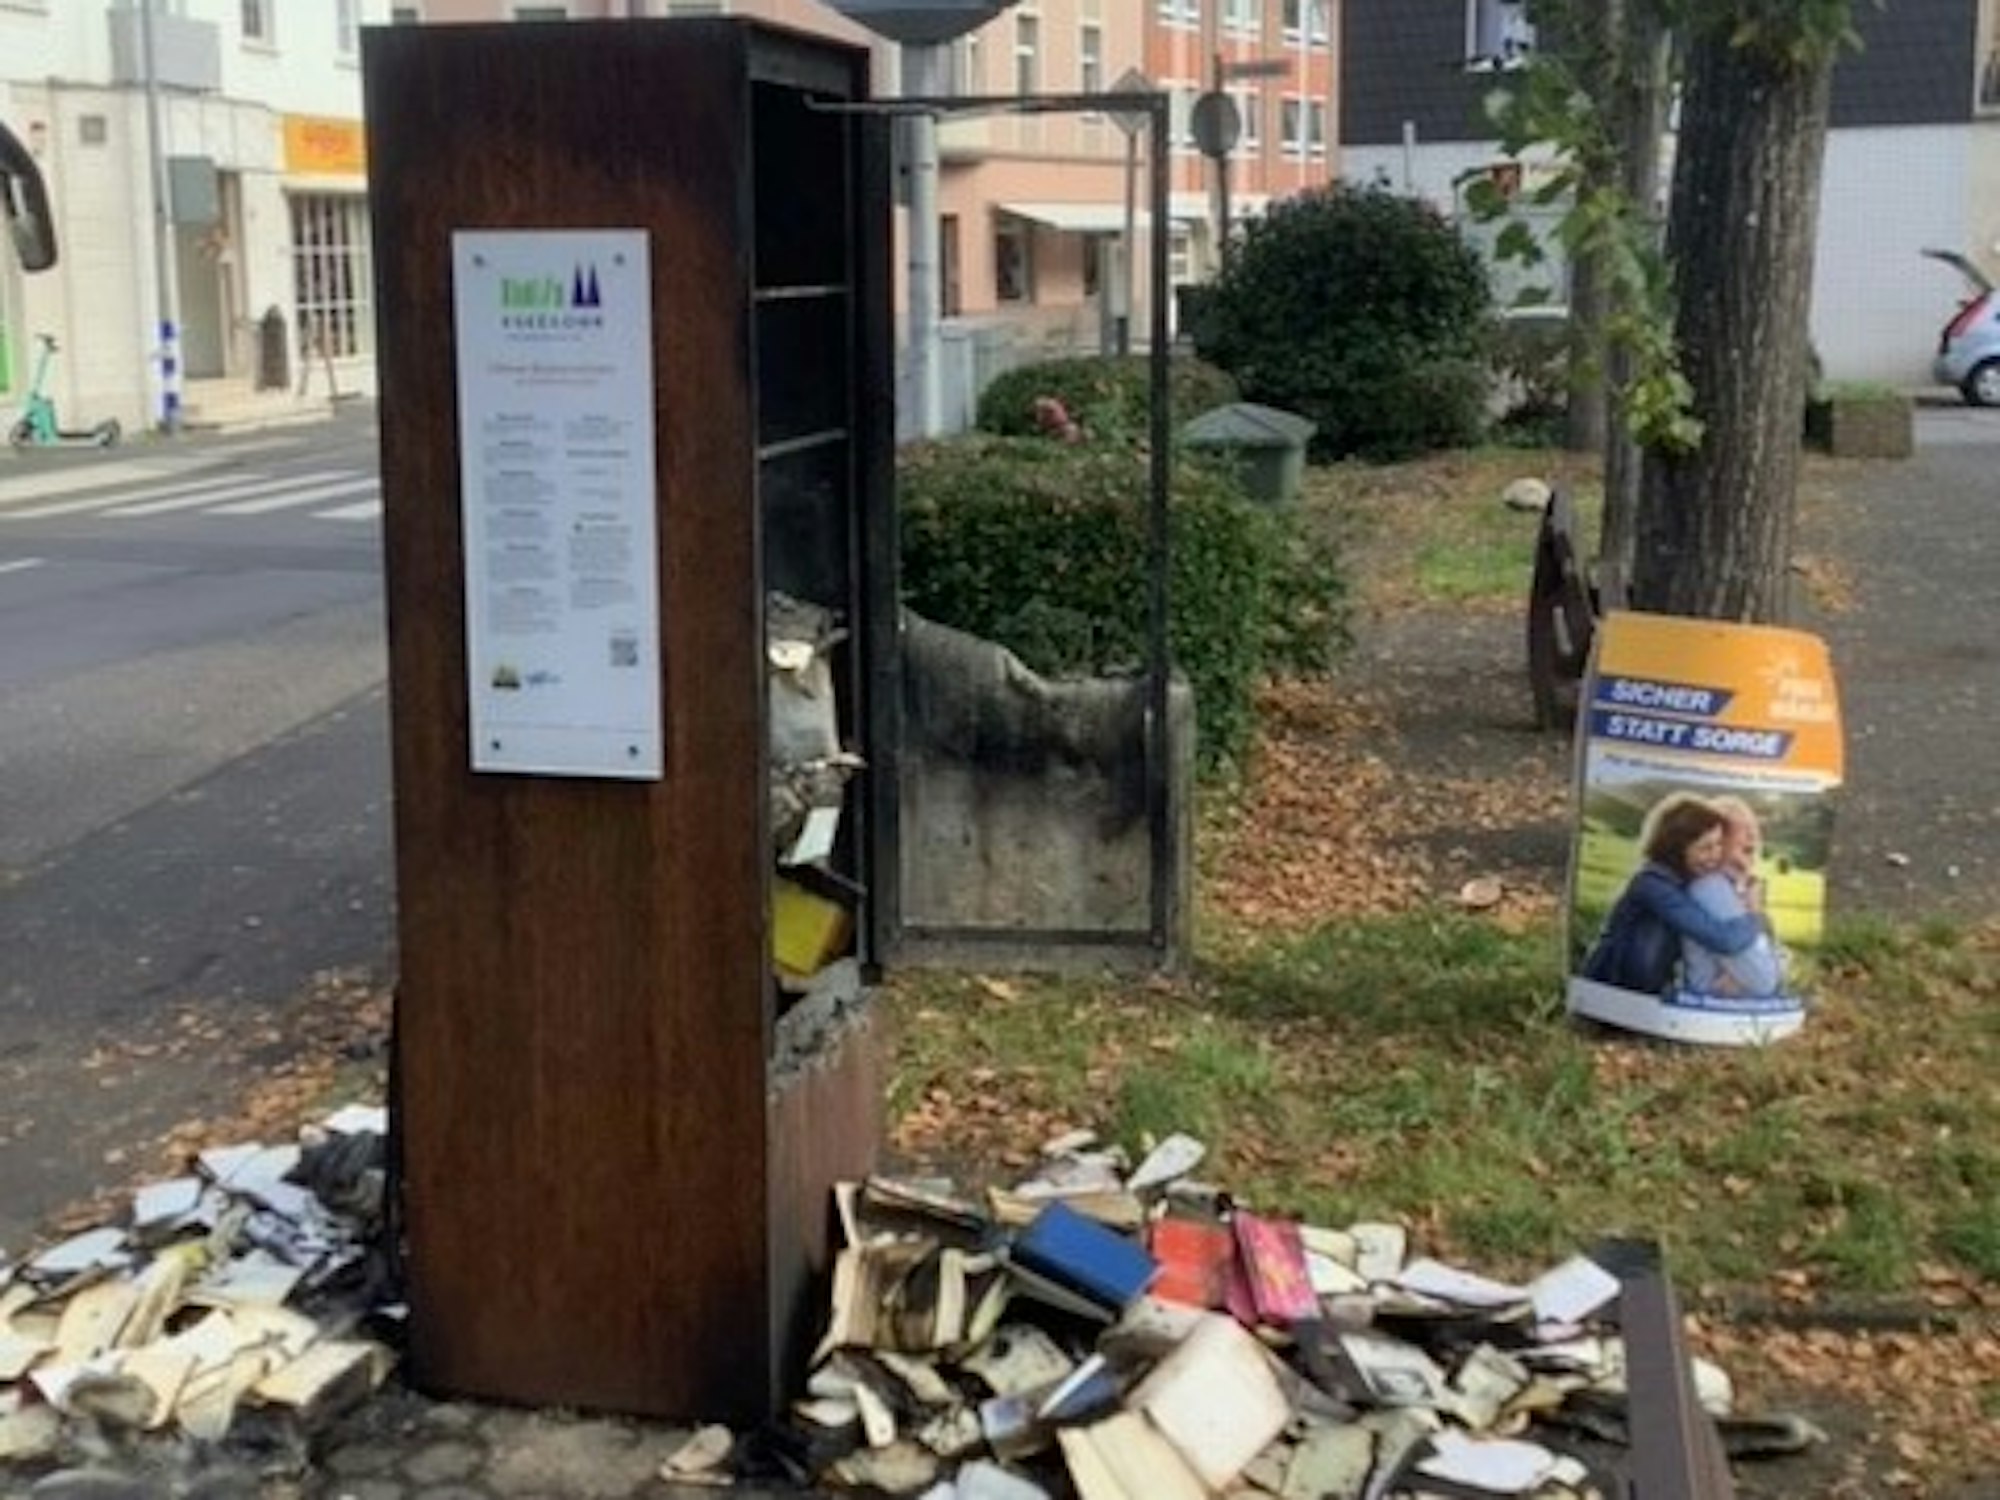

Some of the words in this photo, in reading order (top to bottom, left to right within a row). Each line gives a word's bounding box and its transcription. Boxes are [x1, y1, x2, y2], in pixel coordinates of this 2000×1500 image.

[1611, 679, 1711, 711] SICHER
[1607, 715, 1684, 743] STATT
[1693, 724, 1780, 754] SORGE
